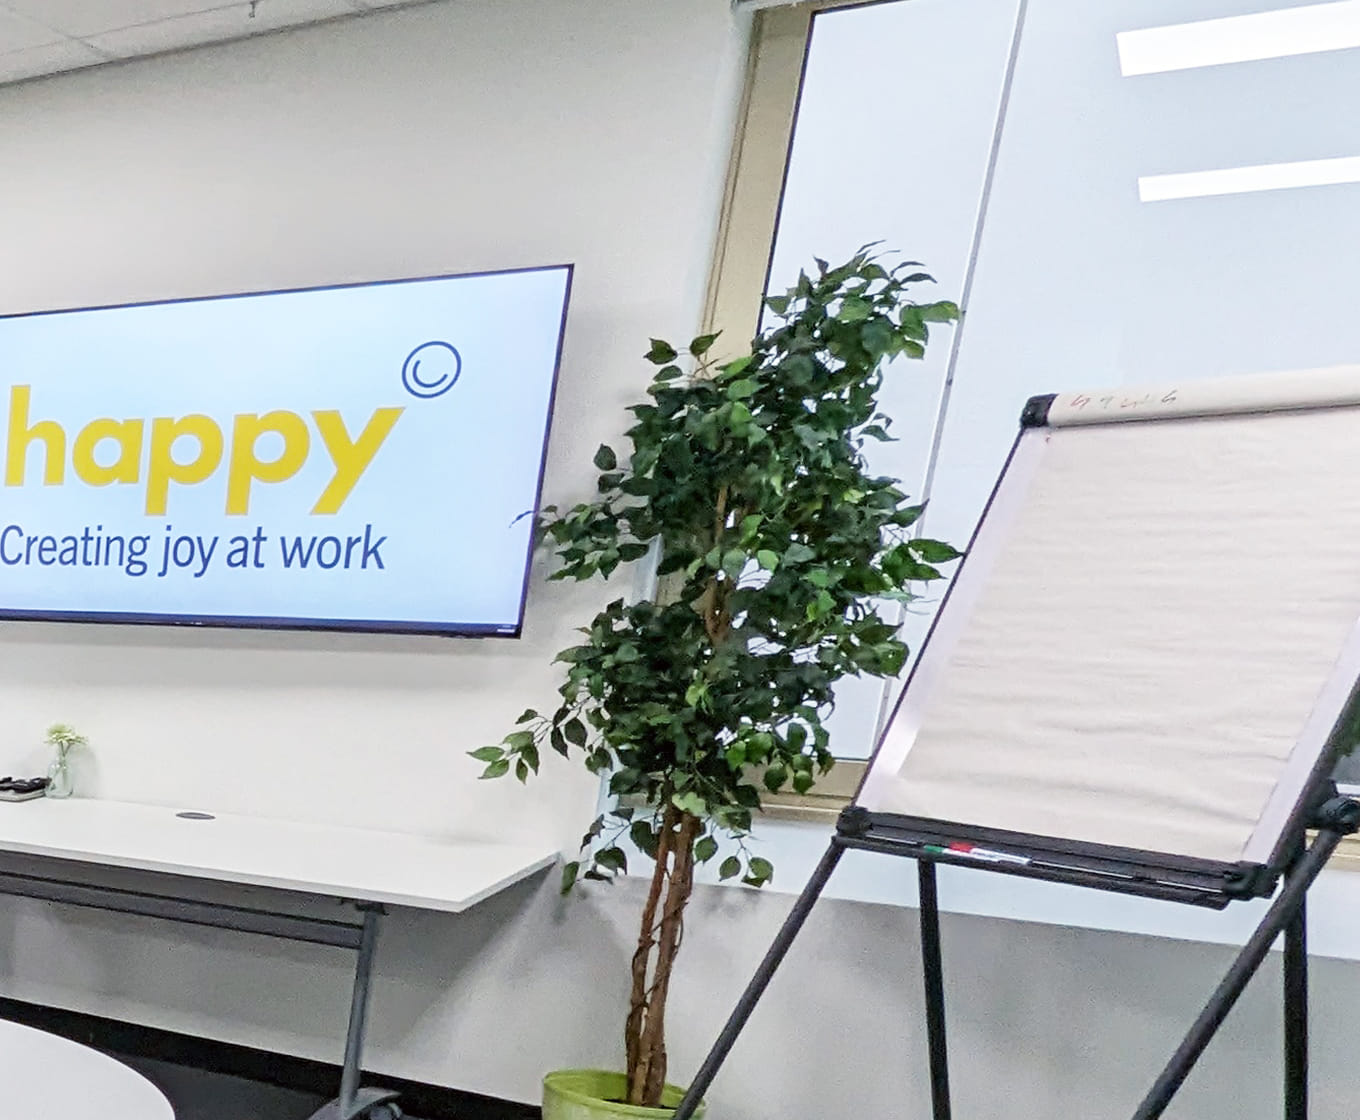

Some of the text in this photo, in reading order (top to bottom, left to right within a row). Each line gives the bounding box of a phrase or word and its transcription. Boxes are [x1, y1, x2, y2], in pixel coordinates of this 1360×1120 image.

[4, 384, 406, 516] happy
[0, 524, 386, 578] Creating joy at work
